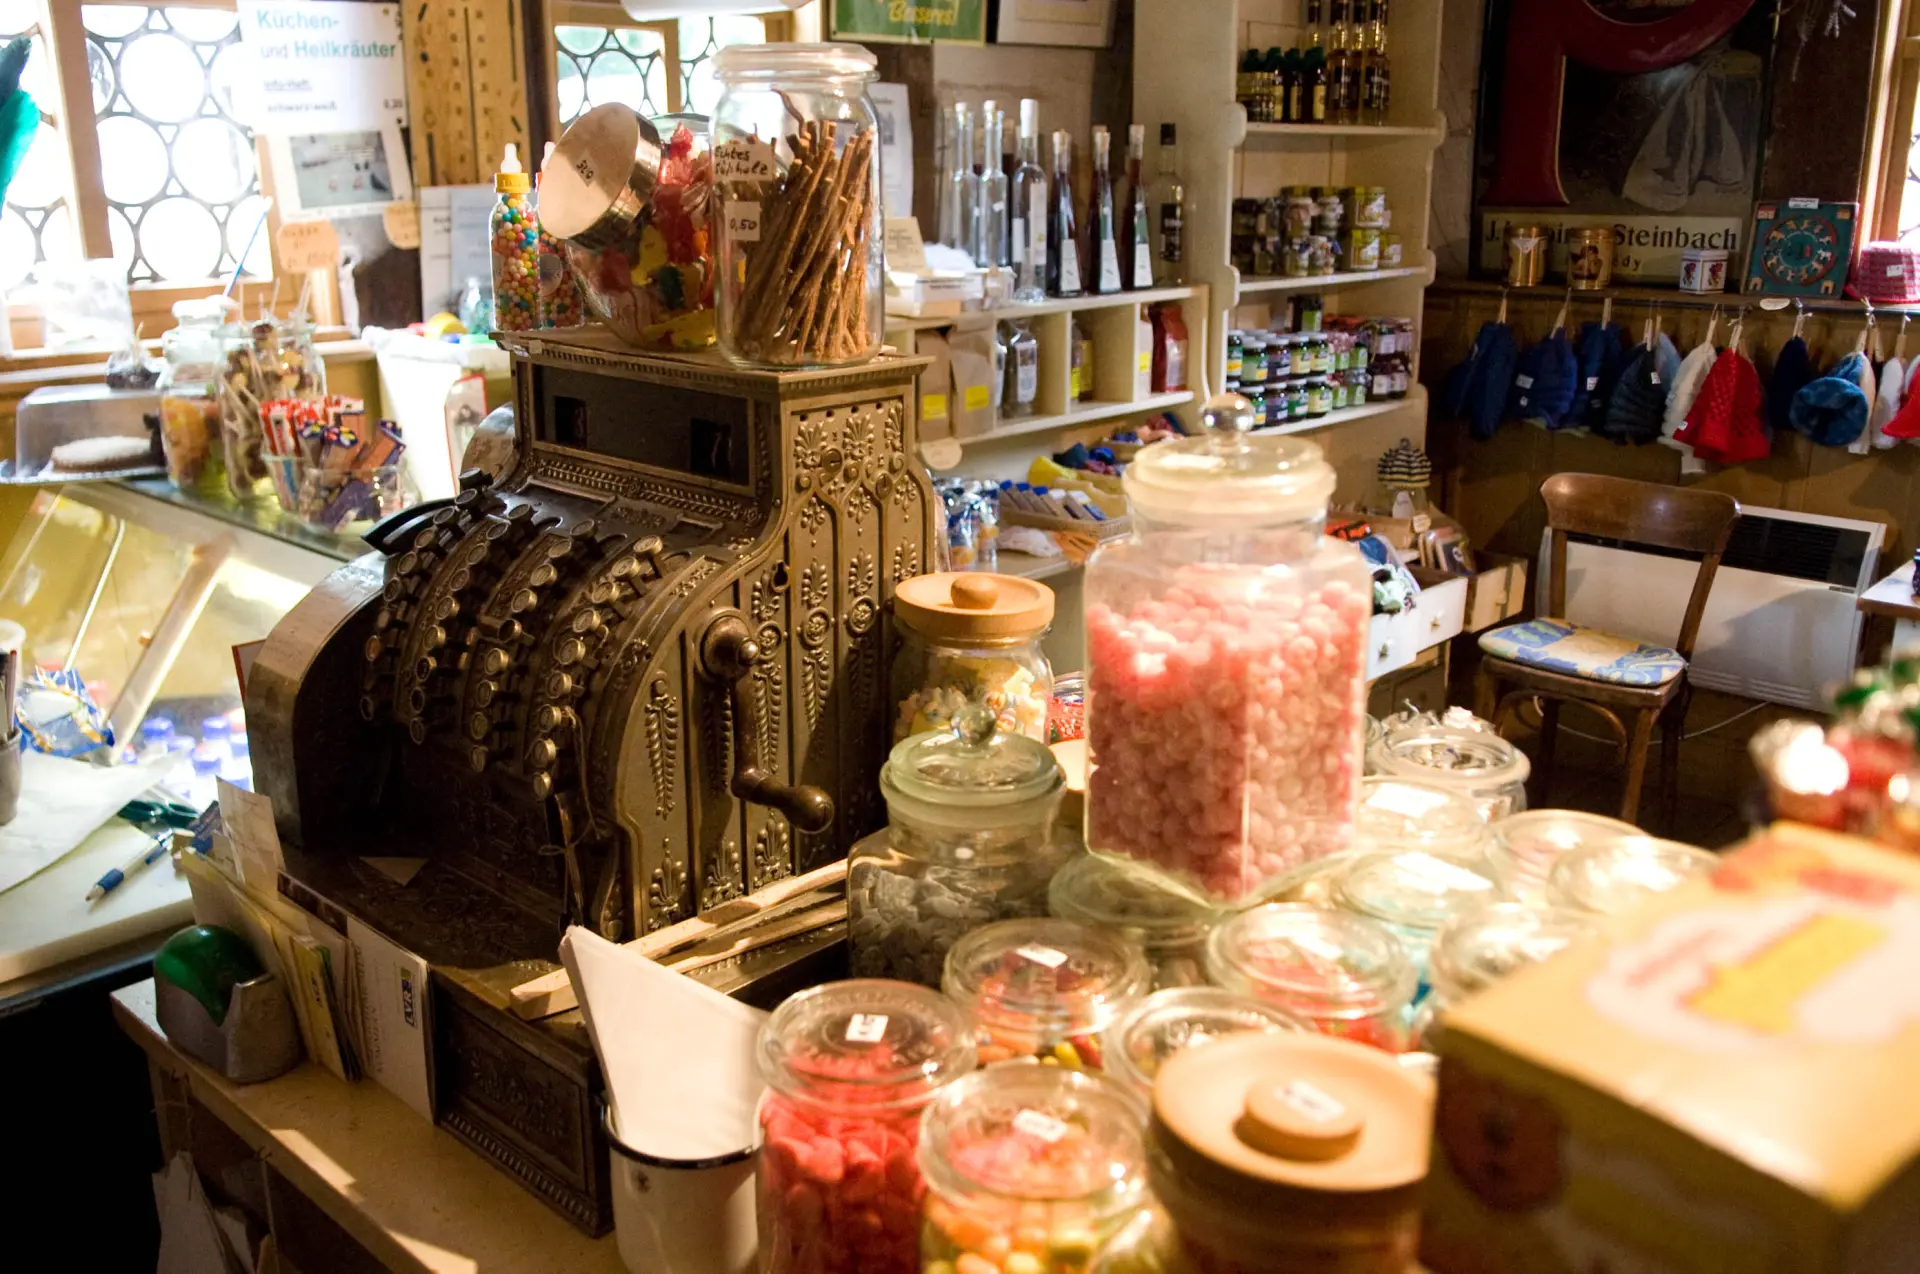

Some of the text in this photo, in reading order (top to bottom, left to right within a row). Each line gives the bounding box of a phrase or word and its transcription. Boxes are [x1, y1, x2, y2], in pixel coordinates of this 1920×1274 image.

[256, 8, 340, 30] Küchen-
[260, 39, 397, 59] und Heilkräuter
[714, 145, 751, 161] Echtes
[729, 218, 758, 232] 0,50
[1612, 223, 1738, 250] Steinbach
